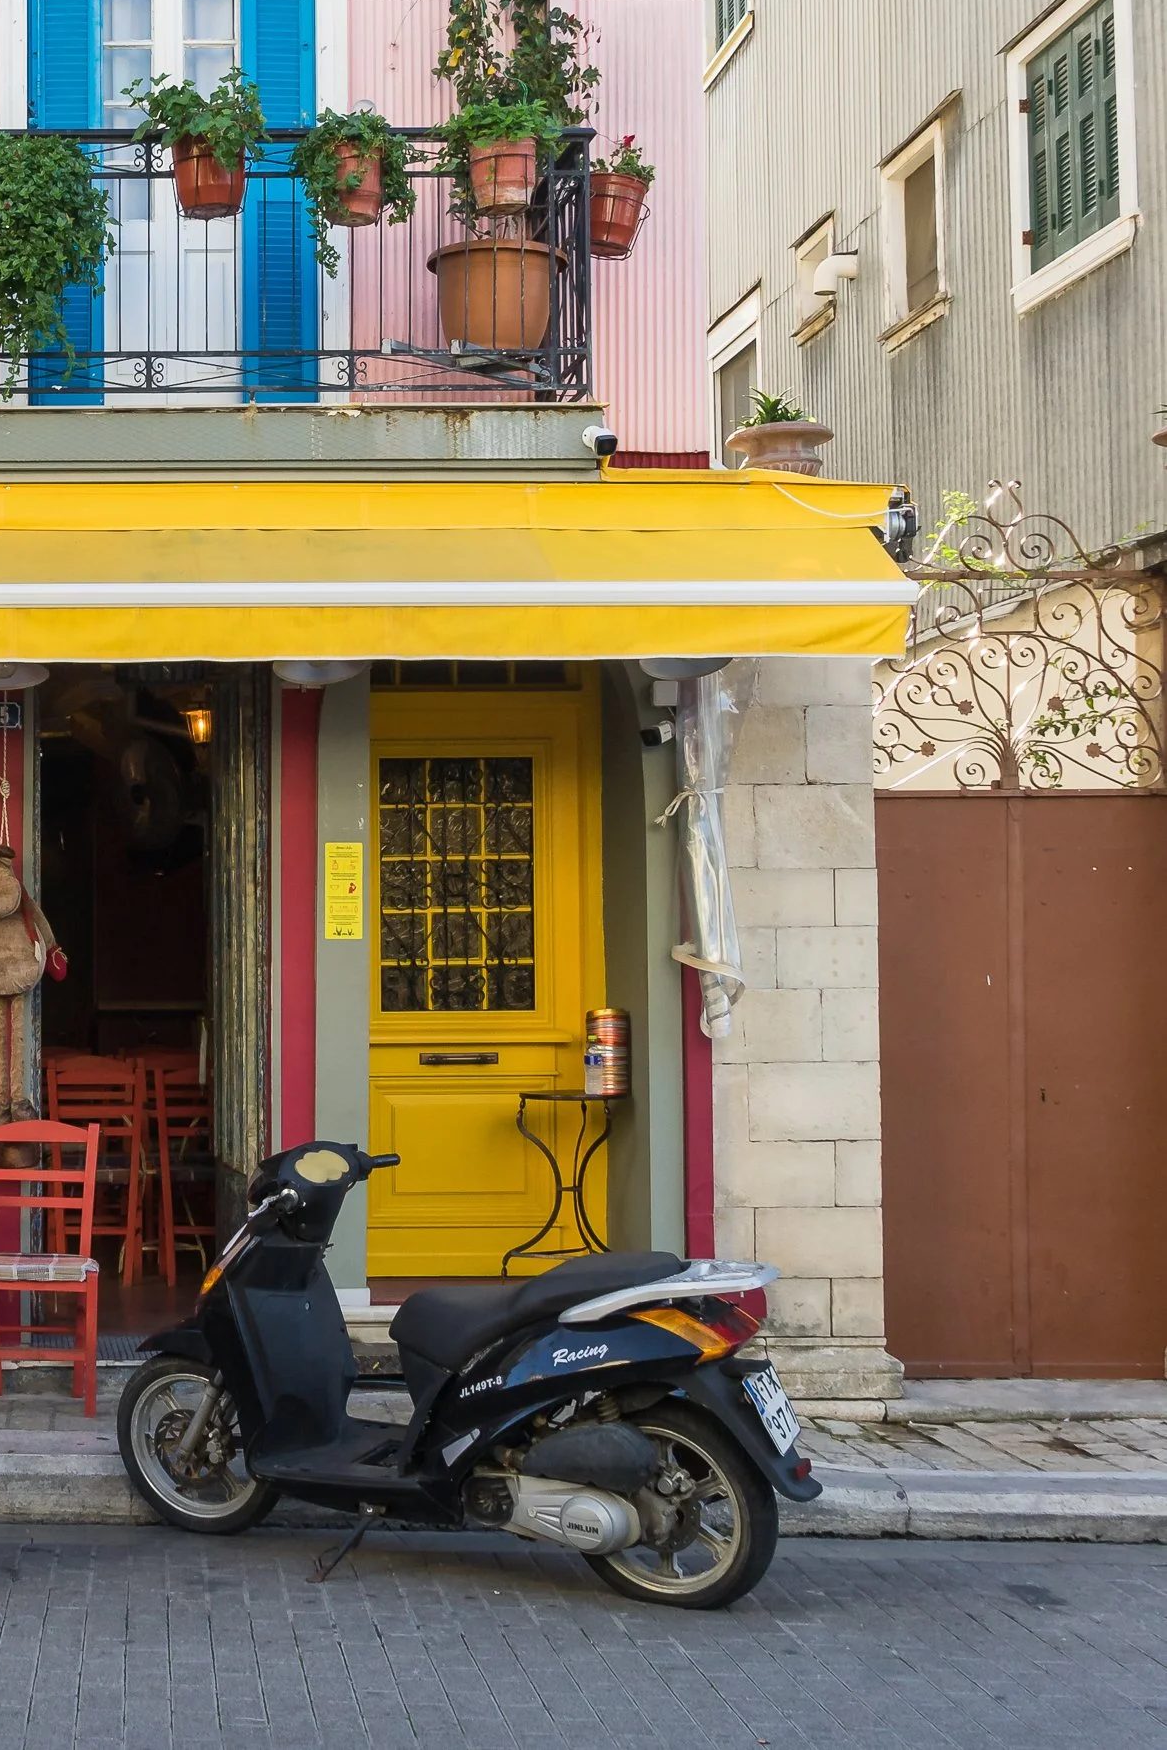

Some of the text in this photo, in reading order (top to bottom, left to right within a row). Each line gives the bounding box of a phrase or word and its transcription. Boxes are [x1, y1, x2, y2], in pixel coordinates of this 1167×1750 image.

[552, 1343, 609, 1367] Racing
[459, 1375, 503, 1398] JL149T-8
[771, 1399, 797, 1440] 971
[566, 1521, 599, 1535] JINLUN
